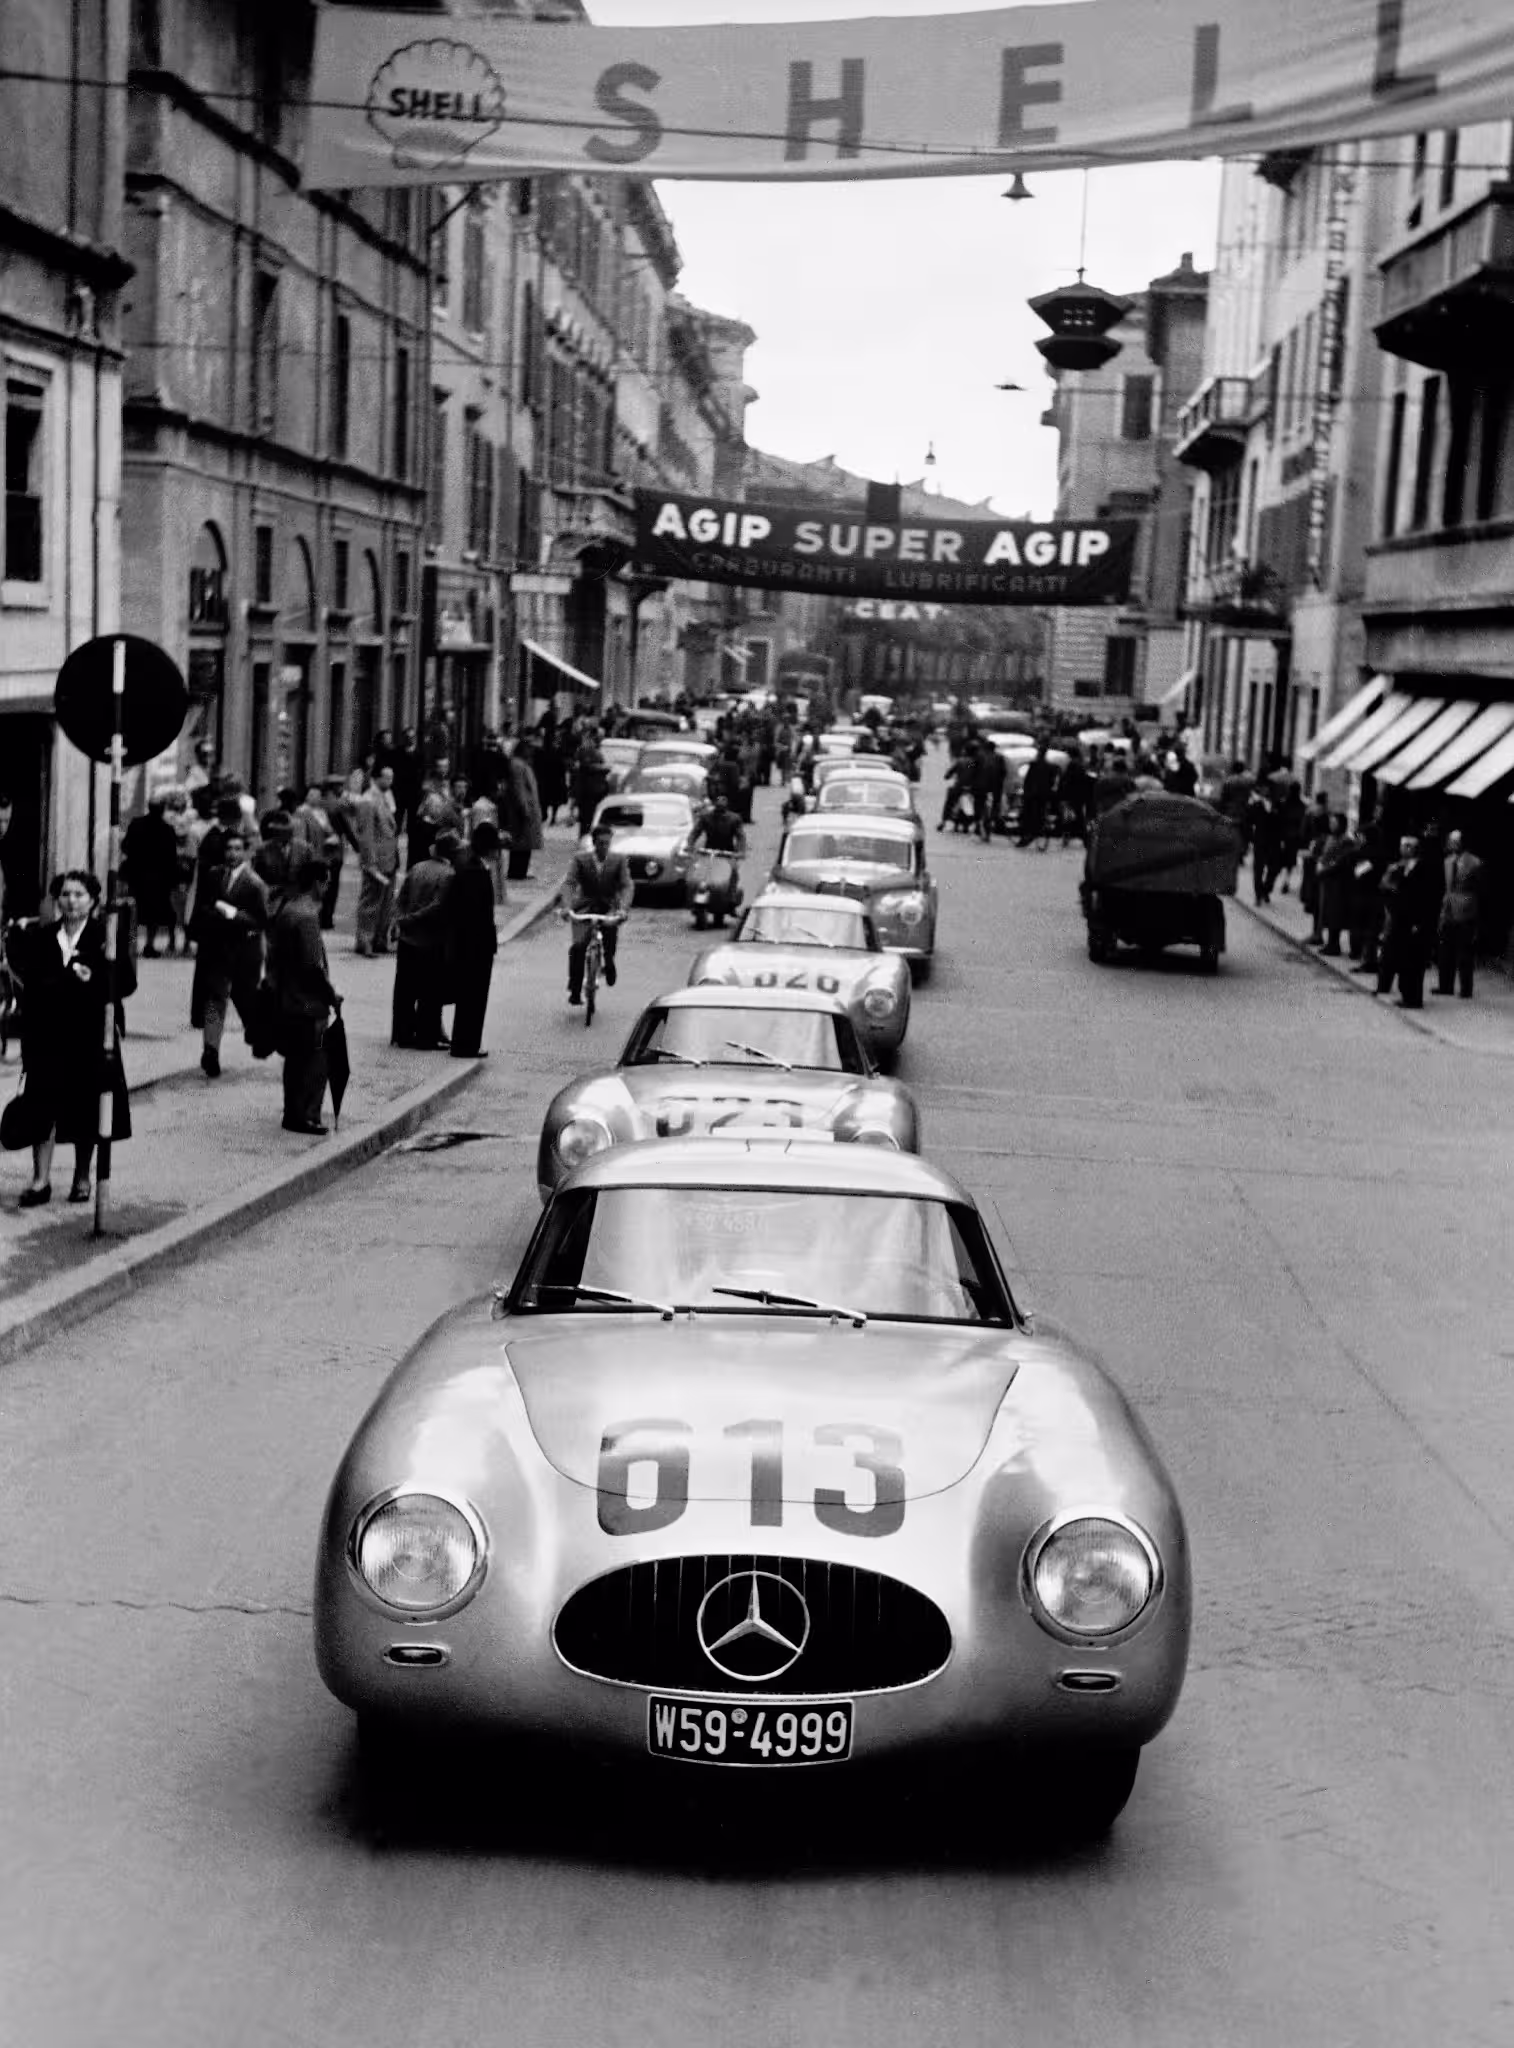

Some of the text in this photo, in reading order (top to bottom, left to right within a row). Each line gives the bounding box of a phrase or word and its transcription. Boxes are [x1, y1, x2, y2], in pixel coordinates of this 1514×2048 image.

[388, 88, 490, 122] SHELL
[652, 503, 1111, 566] AGIP SUPER AGIP
[884, 569, 1069, 592] LUBRIFICANTI
[855, 602, 944, 620] CEAT
[596, 1419, 906, 1538] 613
